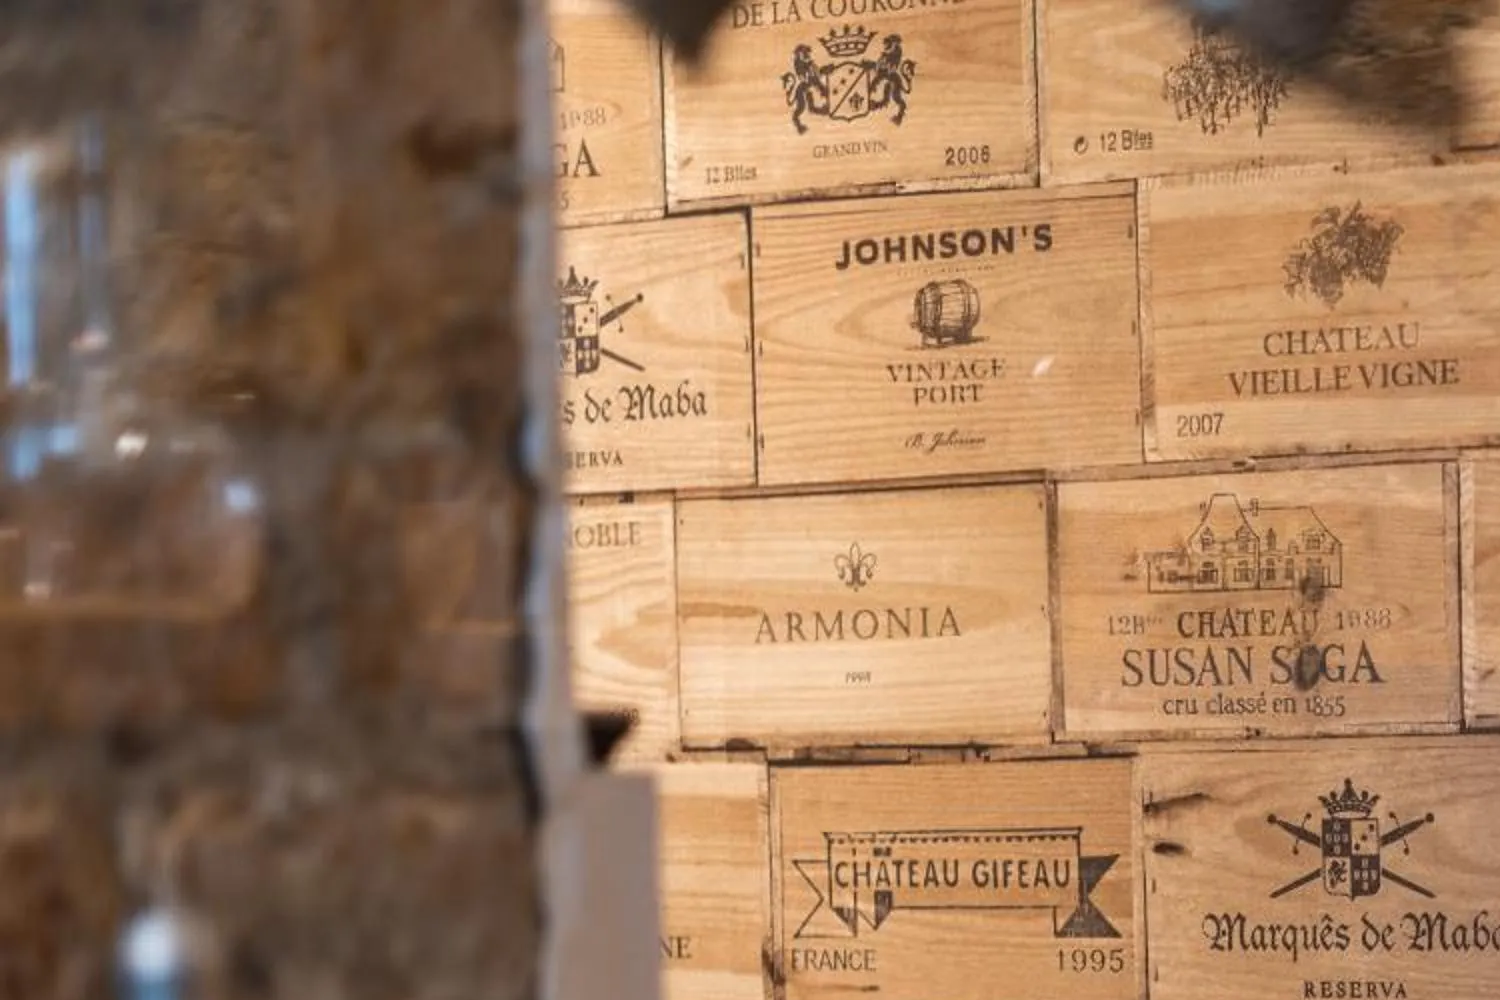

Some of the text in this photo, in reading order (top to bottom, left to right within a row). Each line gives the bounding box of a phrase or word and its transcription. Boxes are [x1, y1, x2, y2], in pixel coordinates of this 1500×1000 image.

[732, 2, 765, 28] DE
[772, 0, 801, 24] LA
[813, 139, 888, 158] GRAND VIN
[1100, 131, 1117, 152] 12
[835, 223, 1053, 271] JOHNSON'S
[1263, 322, 1420, 358] CHATEAU
[885, 358, 1006, 382] VINTAGE
[1228, 359, 1460, 397] VIEILLE VIGNE
[584, 388, 612, 424] de
[616, 379, 709, 421] Maba
[912, 383, 983, 406] PORT
[1176, 413, 1224, 438] 2007
[573, 521, 641, 548] OBLE
[754, 606, 962, 644] ARMONIA
[1176, 607, 1320, 639] CHATEAU
[1121, 647, 1252, 688] SUSAN
[1162, 692, 1346, 717] cru classé en 1855
[834, 858, 1071, 890] CHATEAU GIFEAU
[1202, 911, 1350, 962] Marquês
[1361, 913, 1394, 950] de
[791, 948, 876, 971] FRANCE
[1057, 949, 1124, 974] 1995
[1303, 979, 1408, 1000] RESERVA
